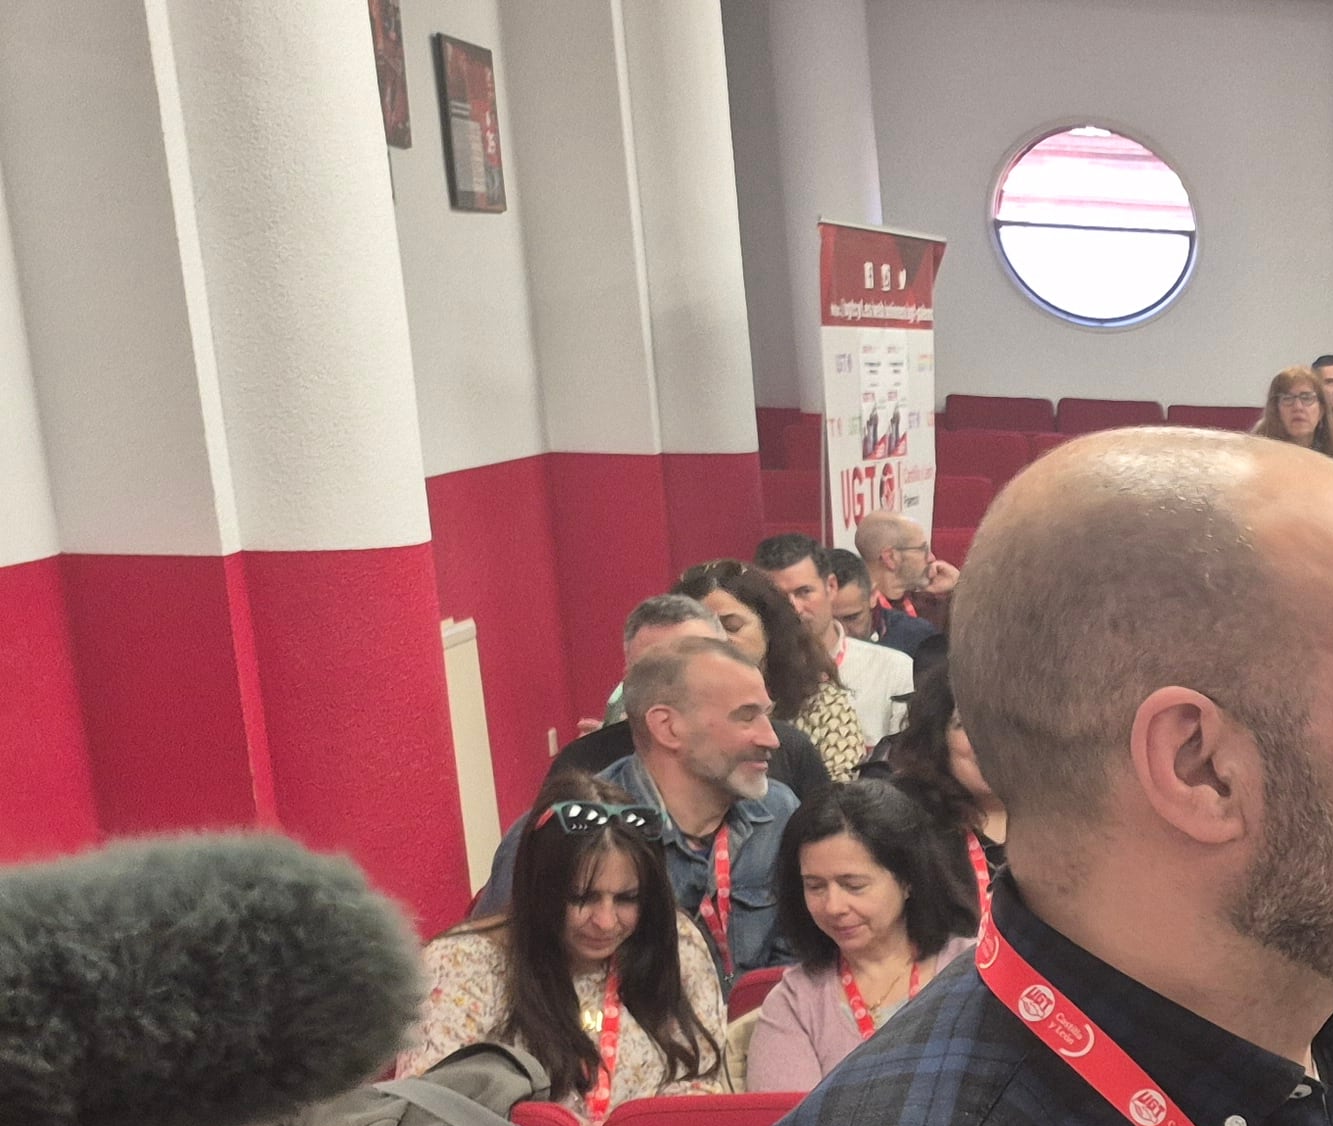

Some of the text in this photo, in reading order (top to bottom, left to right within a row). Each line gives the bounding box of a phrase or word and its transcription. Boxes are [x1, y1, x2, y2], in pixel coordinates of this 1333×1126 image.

[1025, 987, 1054, 1012] UGT
[1056, 1012, 1083, 1041] Castilla
[1137, 1091, 1166, 1118] UGT
